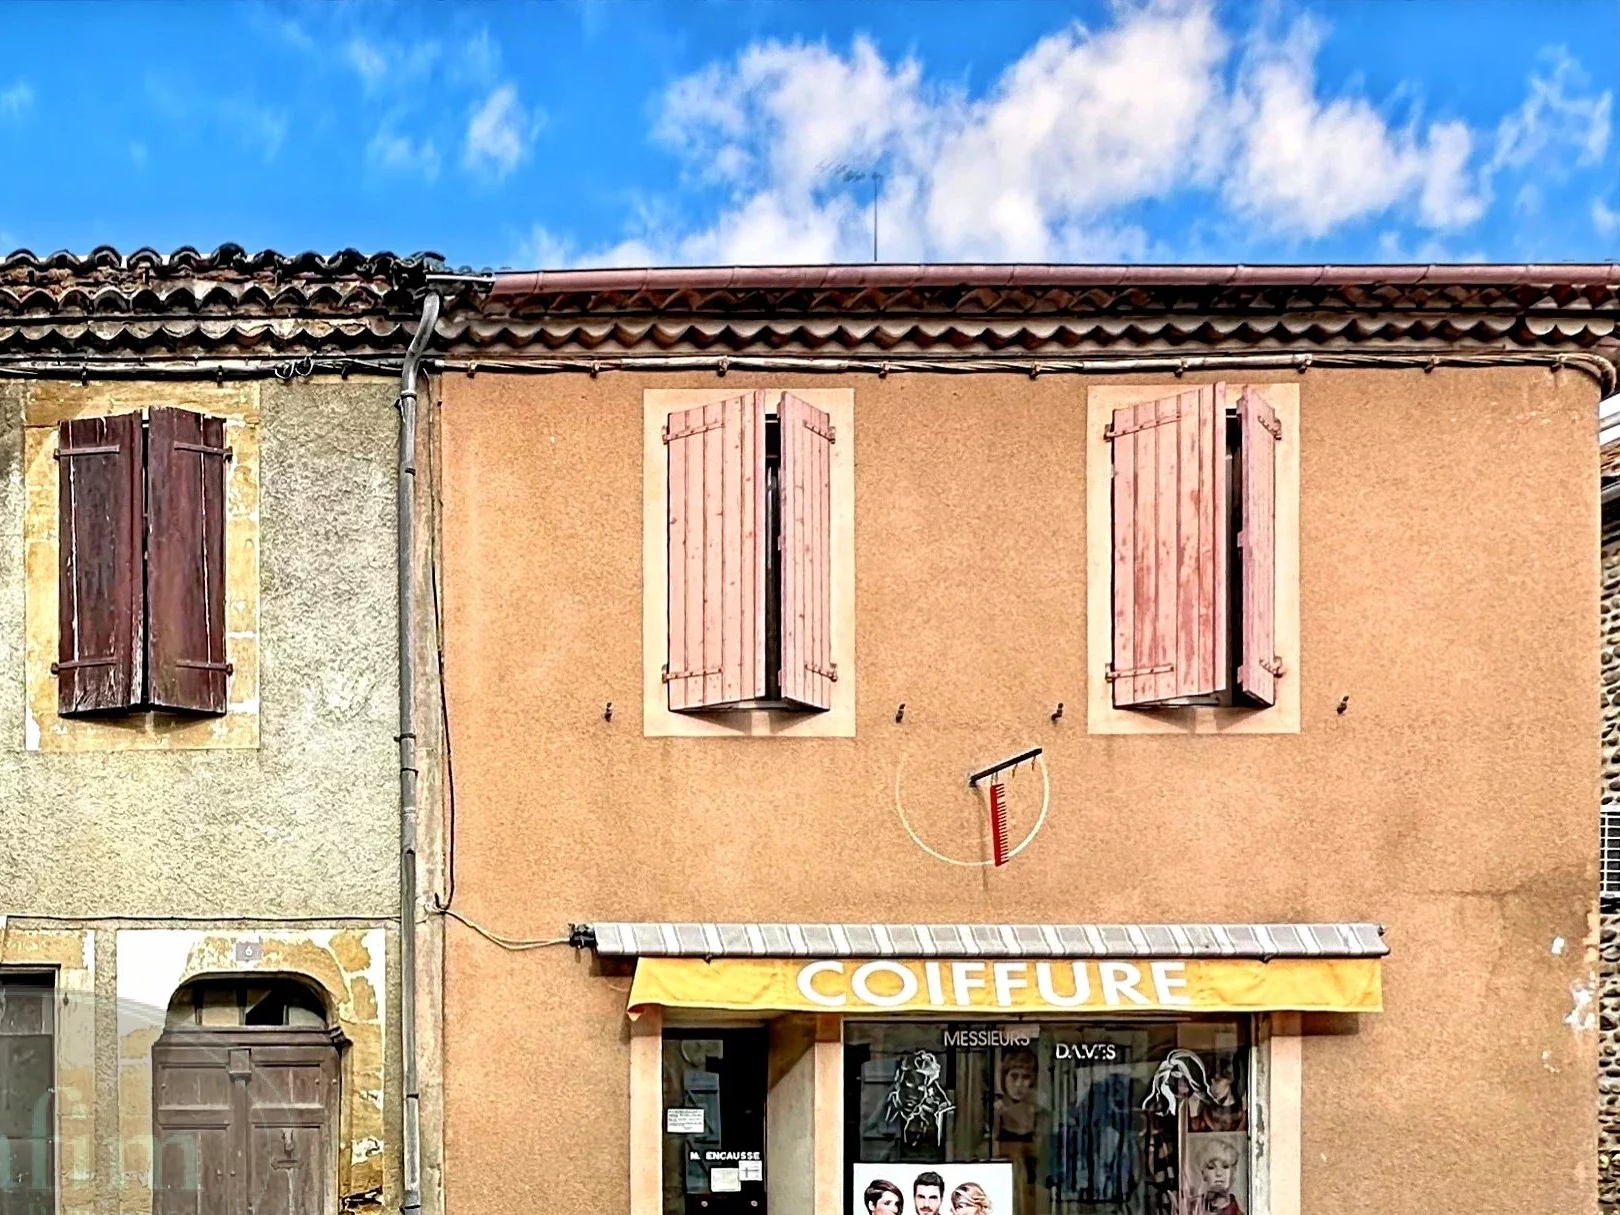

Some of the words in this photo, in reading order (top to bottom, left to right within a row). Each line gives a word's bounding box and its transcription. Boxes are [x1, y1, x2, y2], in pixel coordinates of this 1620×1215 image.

[796, 960, 1192, 1007] COIFFURE
[943, 1030, 1030, 1047] MESSIEURS
[705, 1151, 760, 1161] ENCAUSSE
